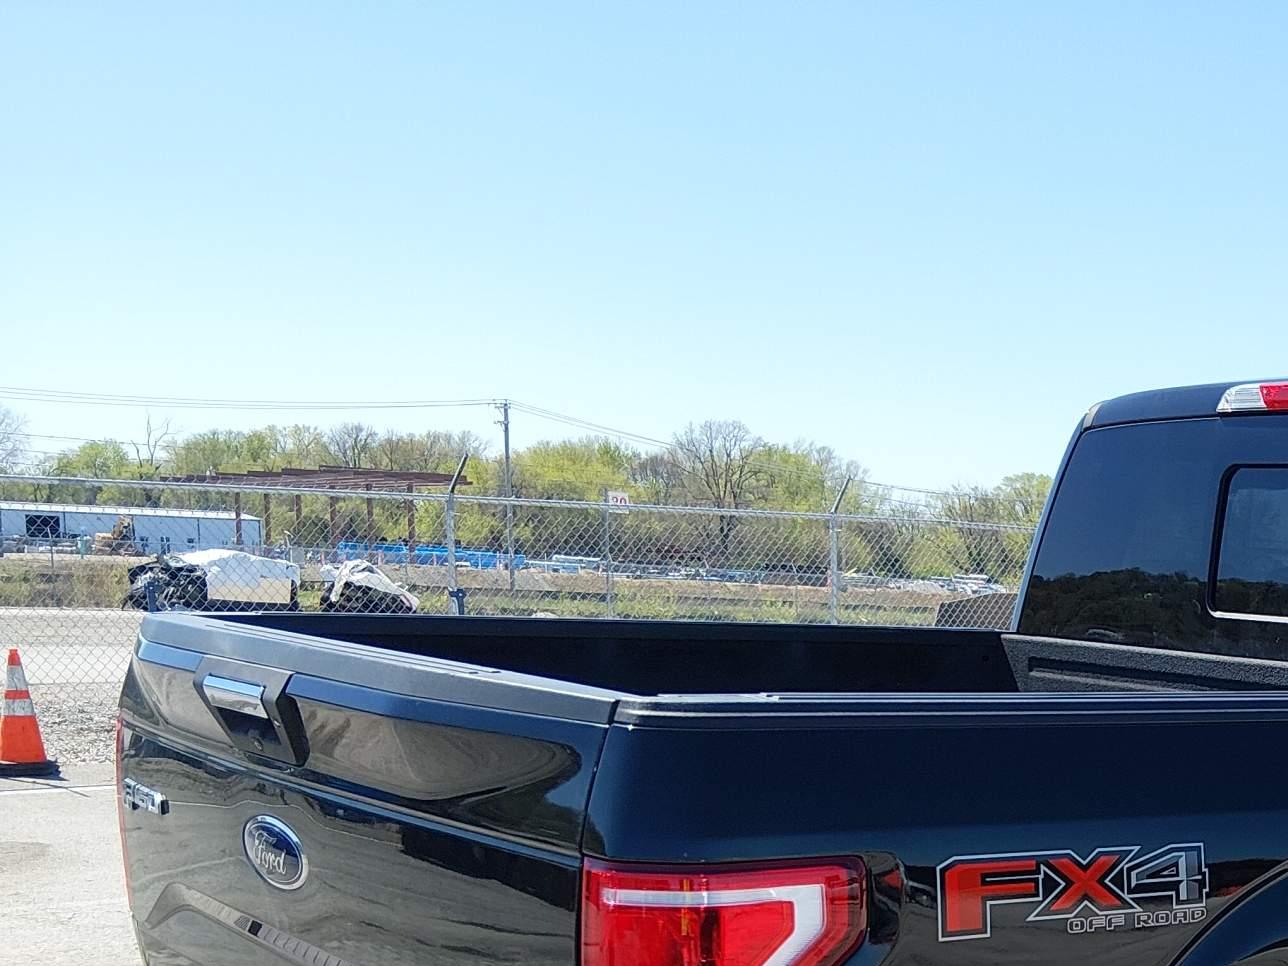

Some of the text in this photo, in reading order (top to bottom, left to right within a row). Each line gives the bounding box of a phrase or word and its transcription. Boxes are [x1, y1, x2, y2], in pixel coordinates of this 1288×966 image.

[251, 830, 287, 876] Ford
[936, 842, 1210, 943] FX4
[1066, 907, 1208, 935] OFF ROAD
